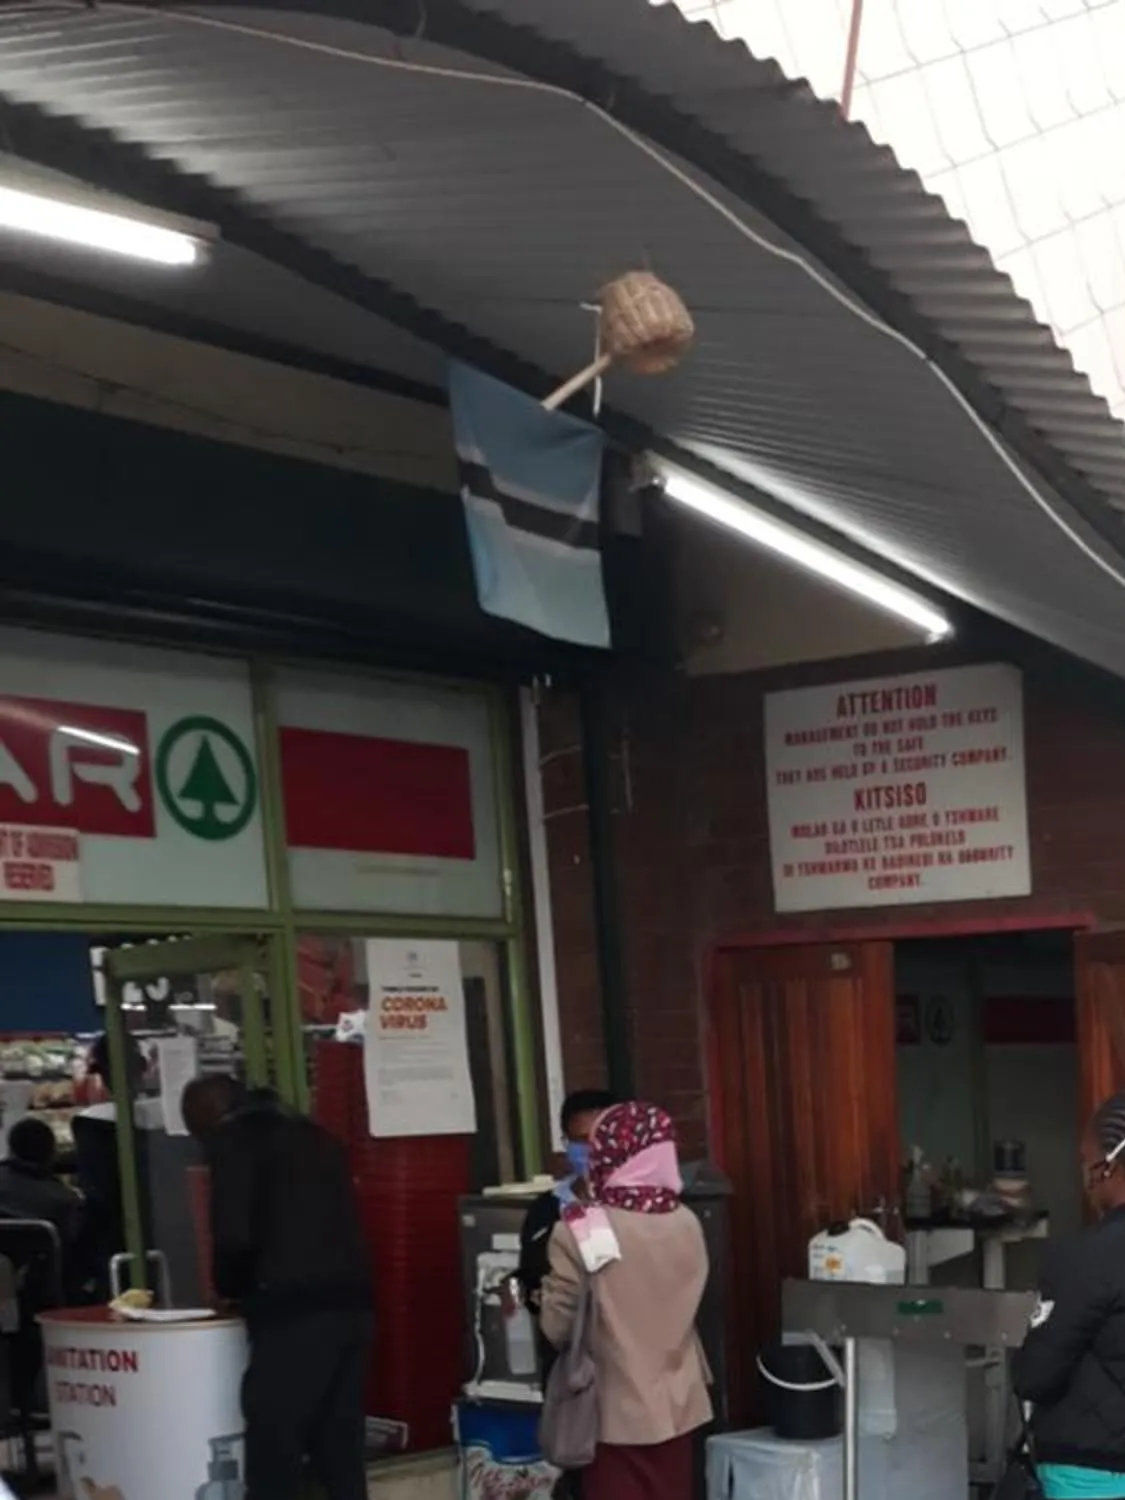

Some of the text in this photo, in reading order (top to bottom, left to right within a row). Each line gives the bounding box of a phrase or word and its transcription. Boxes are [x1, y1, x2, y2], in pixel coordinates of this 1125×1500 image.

[836, 683, 937, 719] ATTENTION
[853, 782, 927, 812] KITSISO
[381, 996, 448, 1012] CORONA
[379, 1014, 428, 1031] VIRUS
